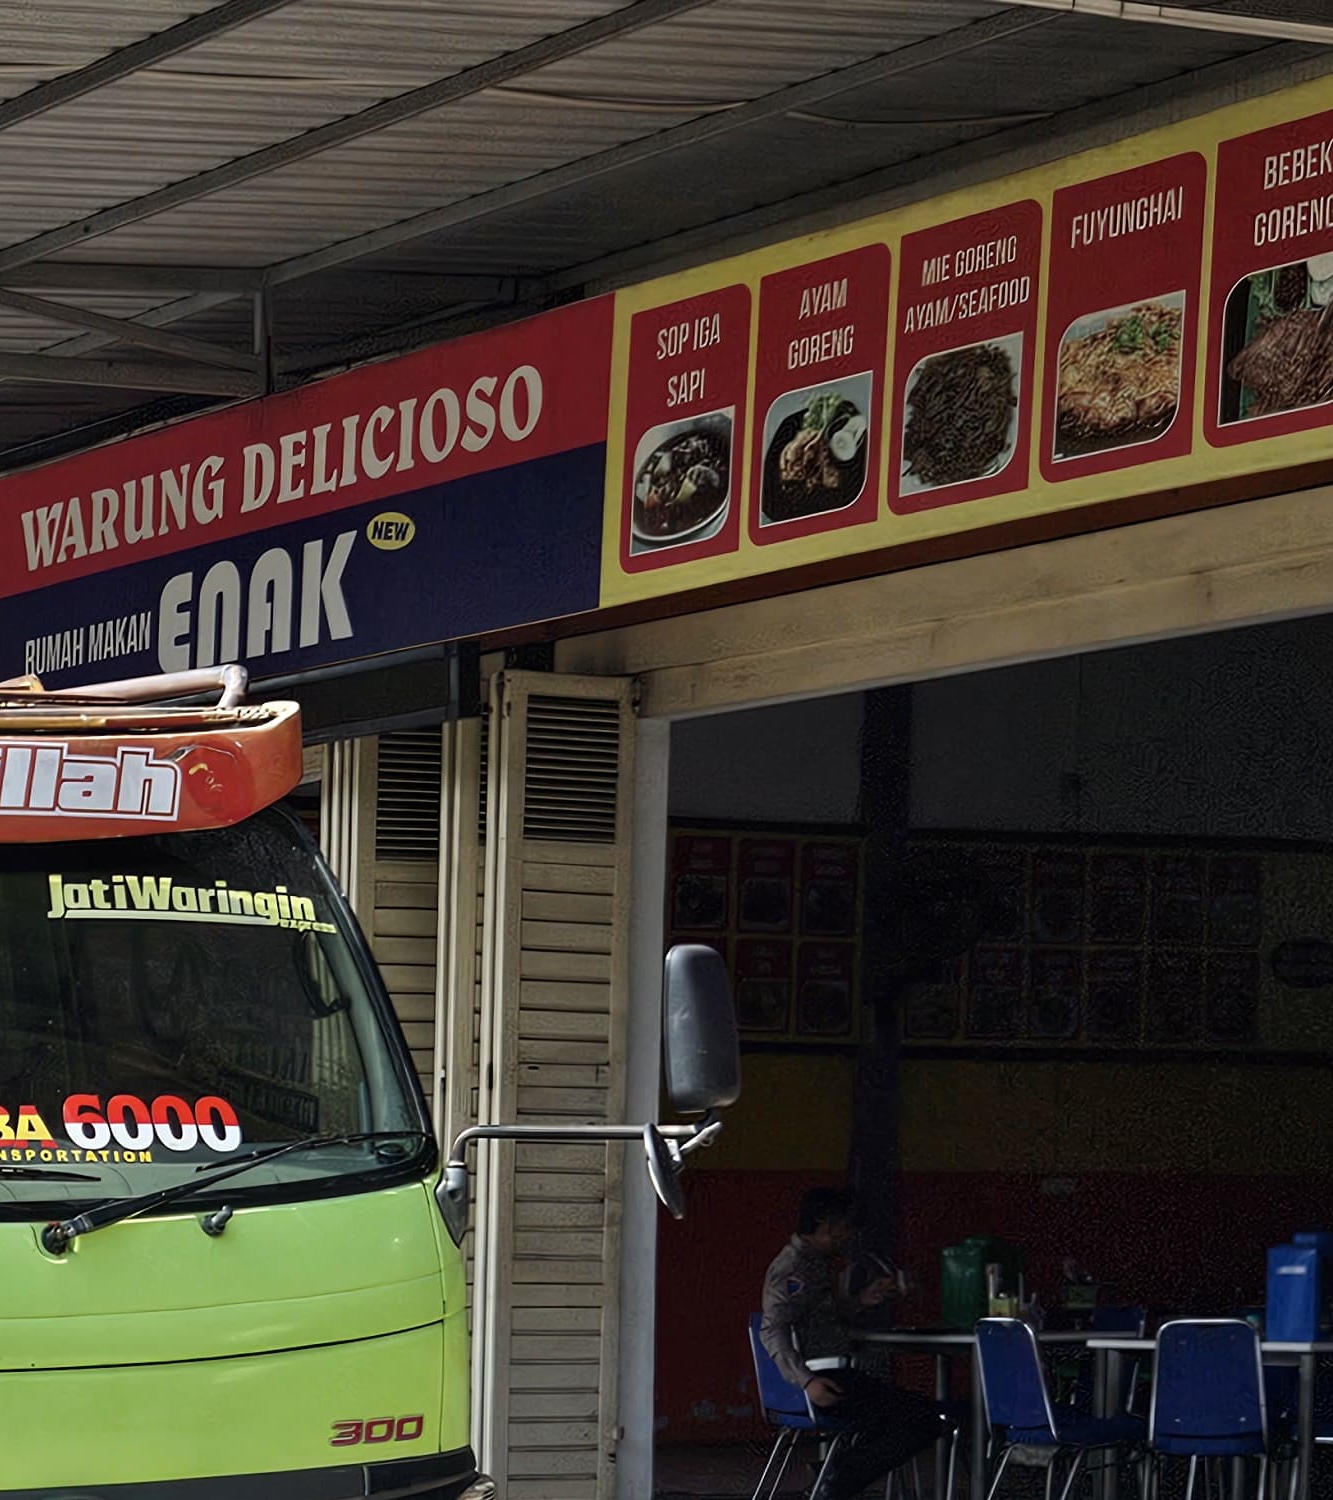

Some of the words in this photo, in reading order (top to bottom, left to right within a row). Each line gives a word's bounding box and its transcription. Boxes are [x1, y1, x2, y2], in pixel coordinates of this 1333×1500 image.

[1264, 137, 1333, 190] BEBEK
[1070, 185, 1184, 249] FUYUNGHAI
[921, 253, 951, 287] MIE
[955, 235, 1017, 277] GORENG
[798, 278, 848, 321] AYAM
[904, 276, 1031, 334] AYAM/SEAFOOD
[656, 321, 690, 361] SOP
[692, 313, 721, 349] IGA
[788, 325, 854, 370] GORENG
[666, 367, 706, 408] SAPI
[21, 455, 227, 571] WARUNG
[240, 364, 544, 513] DELICIOSO
[372, 521, 410, 542] NEW
[159, 530, 358, 673] ENAK
[26, 627, 84, 676] RUMAH
[88, 611, 152, 663] MAKAN
[46, 873, 317, 926] JatiWaringin
[62, 1094, 244, 1153] 6000
[329, 1413, 424, 1447] 300
